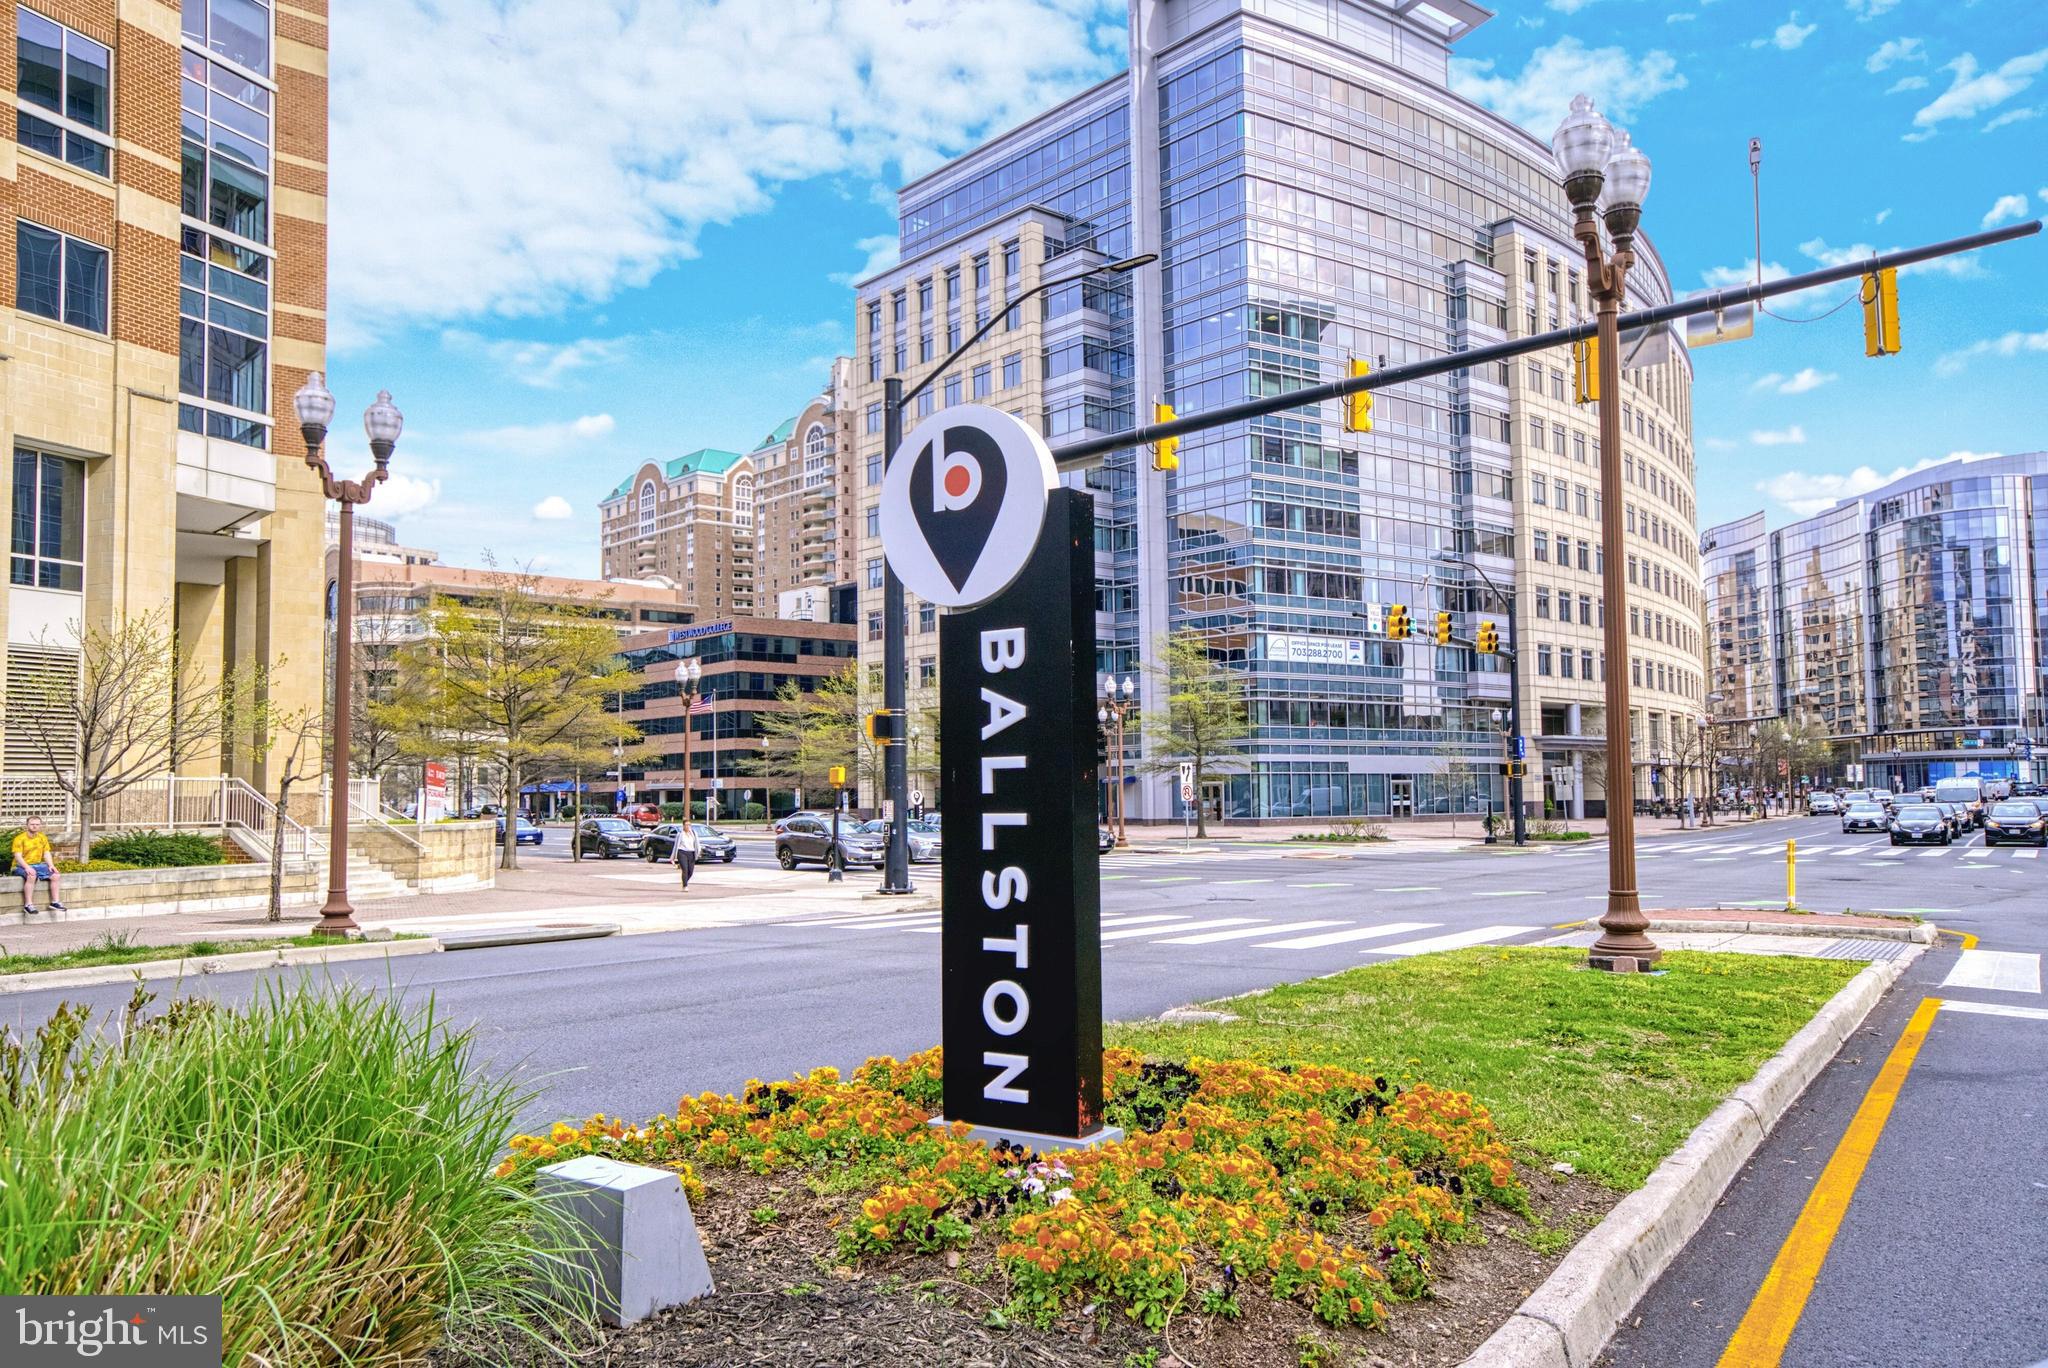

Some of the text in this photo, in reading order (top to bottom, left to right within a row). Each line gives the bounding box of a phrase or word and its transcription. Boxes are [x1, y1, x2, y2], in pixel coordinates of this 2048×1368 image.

[673, 622, 732, 640] WESTWOOD COLLEGE
[1292, 647, 1343, 659] 703.288.2700
[981, 627, 1030, 1104] BALLSTON
